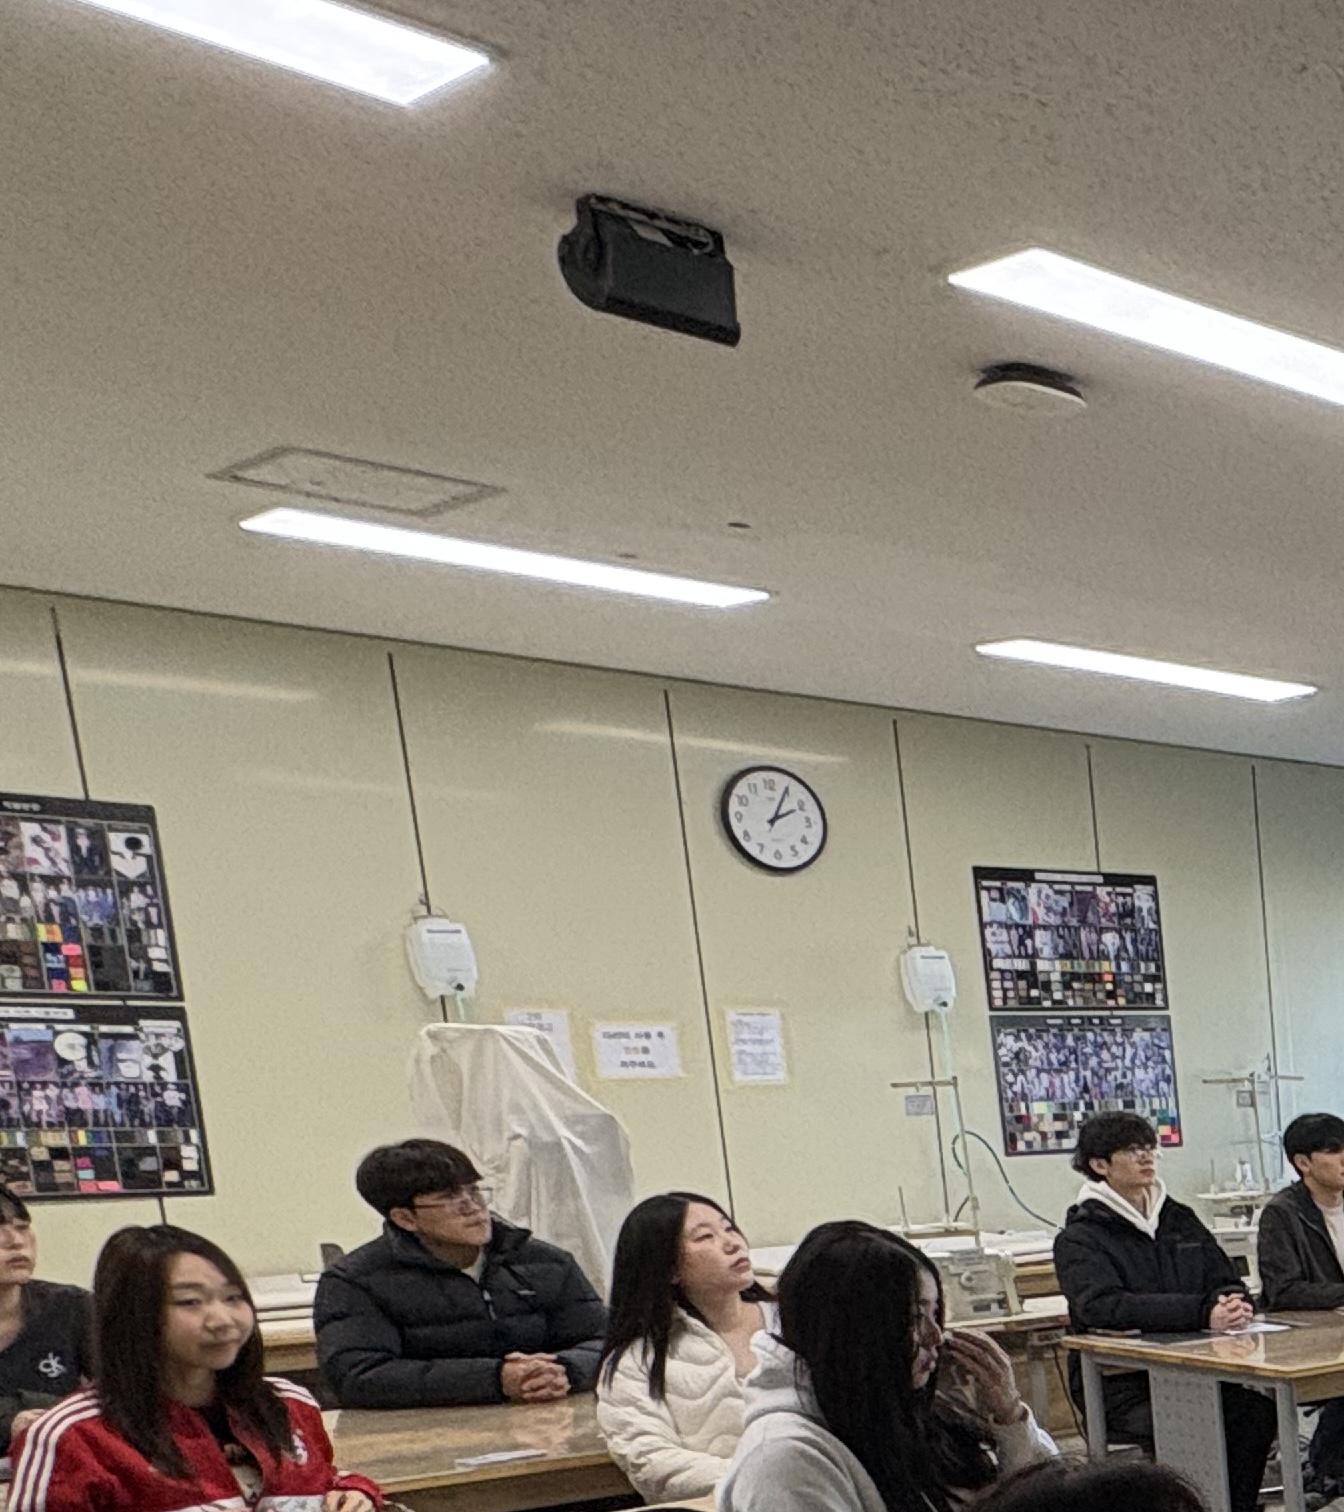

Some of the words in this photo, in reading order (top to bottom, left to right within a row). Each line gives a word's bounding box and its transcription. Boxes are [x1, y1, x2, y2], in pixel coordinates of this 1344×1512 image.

[747, 783, 758, 795] 11
[762, 779, 776, 791] 12
[735, 795, 749, 807] 10
[797, 799, 806, 812] 2
[734, 811, 743, 823] 9
[804, 816, 812, 828] 3
[742, 829, 751, 842] 8
[800, 834, 809, 846] 4
[756, 843, 764, 853] 7
[790, 845, 799, 857] 5
[773, 849, 782, 860] 6
